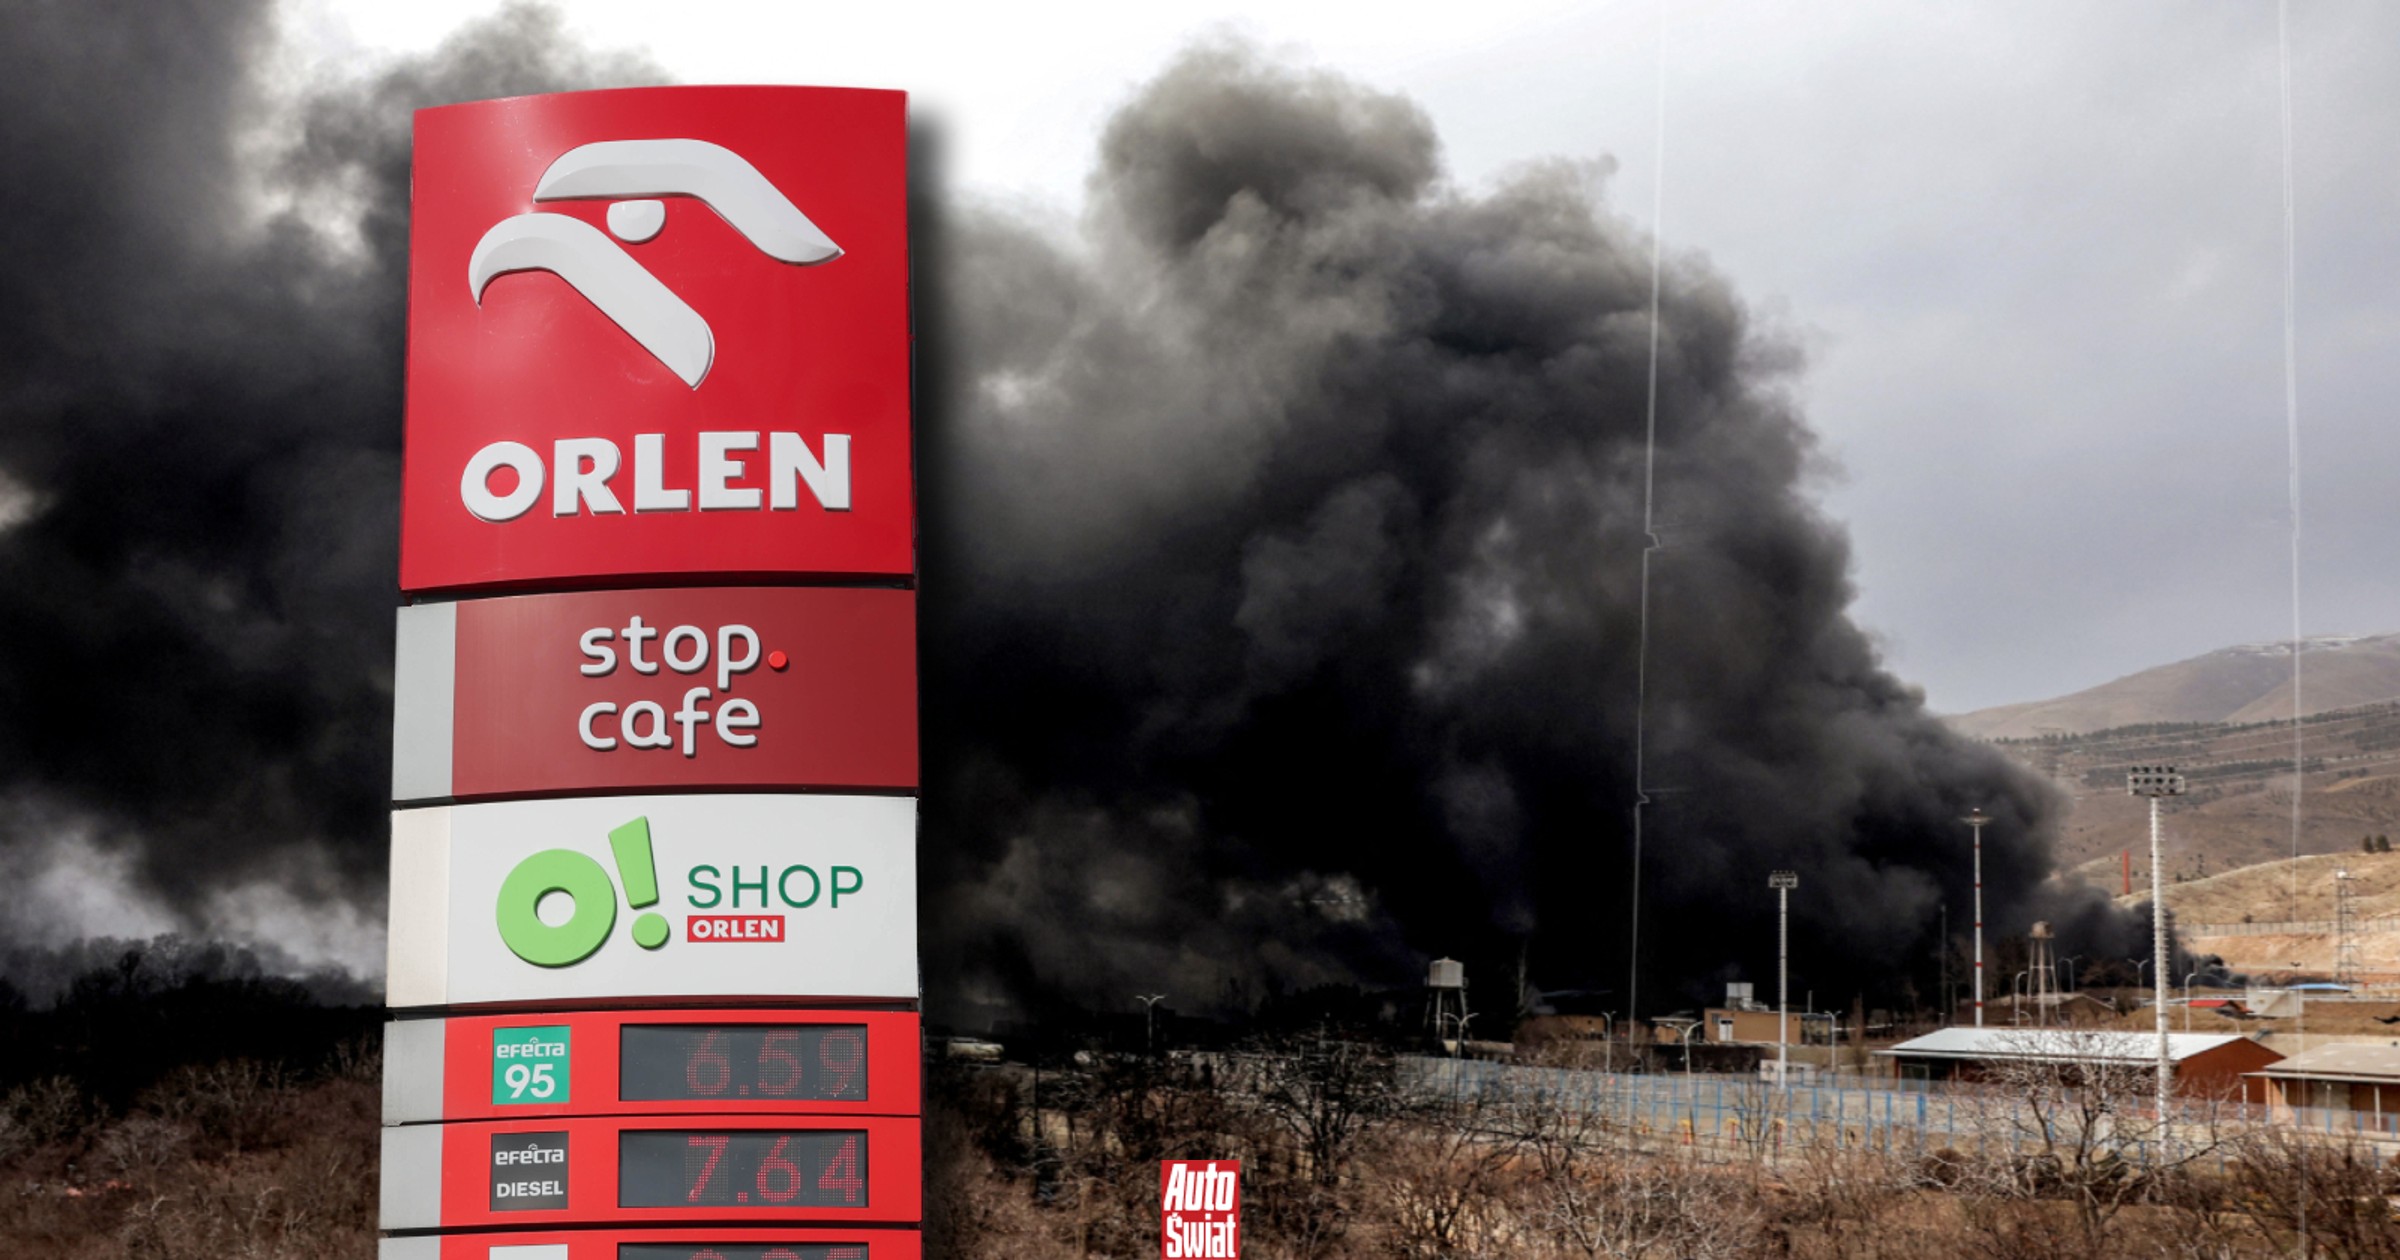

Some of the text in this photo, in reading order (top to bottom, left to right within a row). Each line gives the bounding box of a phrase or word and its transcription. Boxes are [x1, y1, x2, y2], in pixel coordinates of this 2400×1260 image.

[461, 431, 852, 522] ORLEN
[578, 687, 761, 757] cafe
[687, 864, 864, 909] SHOP
[691, 919, 779, 939] ORLEN
[504, 1063, 556, 1099] 95
[687, 1029, 864, 1096] 6.59
[496, 1180, 564, 1198] DIESEL
[687, 1136, 863, 1202] 7.64
